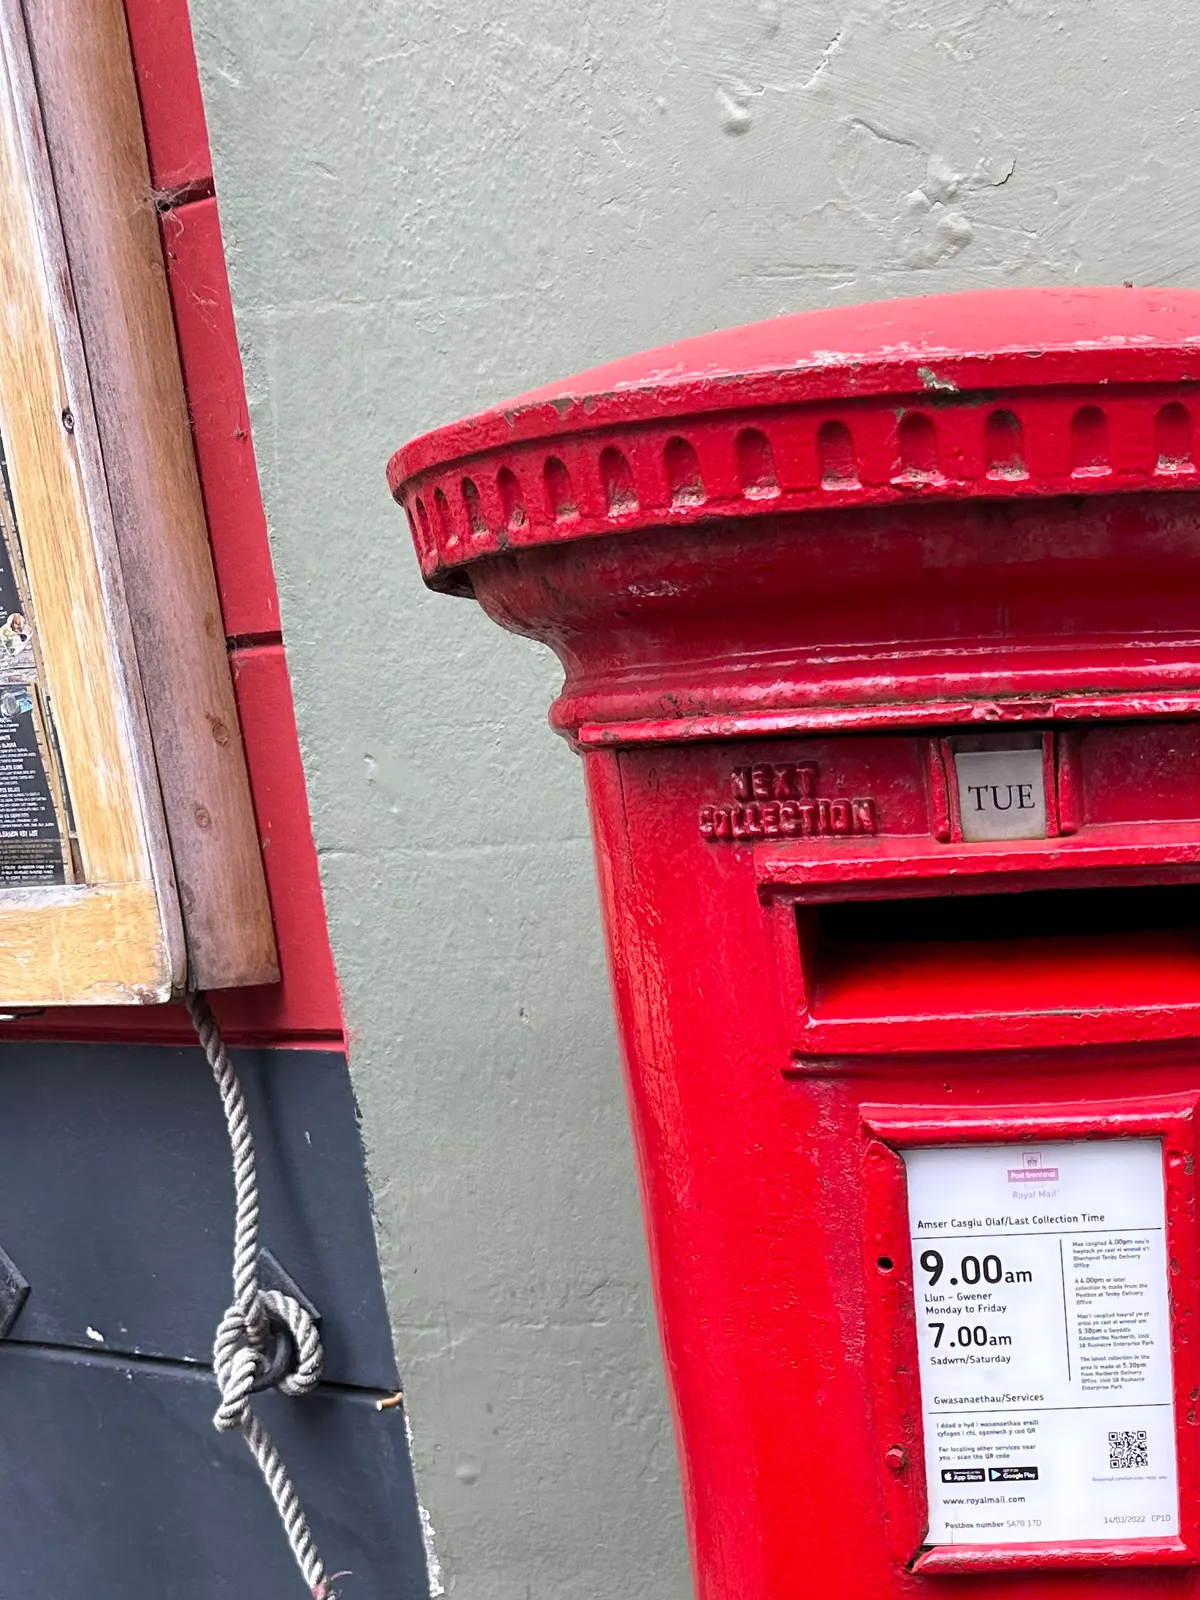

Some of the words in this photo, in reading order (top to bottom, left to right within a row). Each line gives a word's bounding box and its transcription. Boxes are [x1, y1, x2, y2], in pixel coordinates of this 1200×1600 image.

[730, 761, 819, 800] NEXT
[967, 784, 1035, 812] TUE
[699, 798, 877, 840] COLLECTION
[1012, 1191, 1036, 1200] Royal
[918, 1220, 948, 1229] Amser
[951, 1219, 982, 1228] Casglu
[986, 1216, 1029, 1227] Olaf/Last
[1032, 1214, 1078, 1224] Collection
[1081, 1213, 1105, 1222] Time
[920, 1250, 1032, 1286] 9.00am
[924, 1294, 944, 1302] Llun
[957, 1292, 992, 1301] Gwener
[926, 1306, 962, 1315] Monday
[978, 1304, 1007, 1313] Friday
[928, 1323, 1012, 1348] 7.00am
[930, 1355, 1011, 1365] Sadwrn/Saturday
[934, 1393, 1044, 1404] Gwasanaethau/Services
[943, 1496, 1025, 1505] www.royalmail.com
[1104, 1516, 1145, 1524] 14/03/2022
